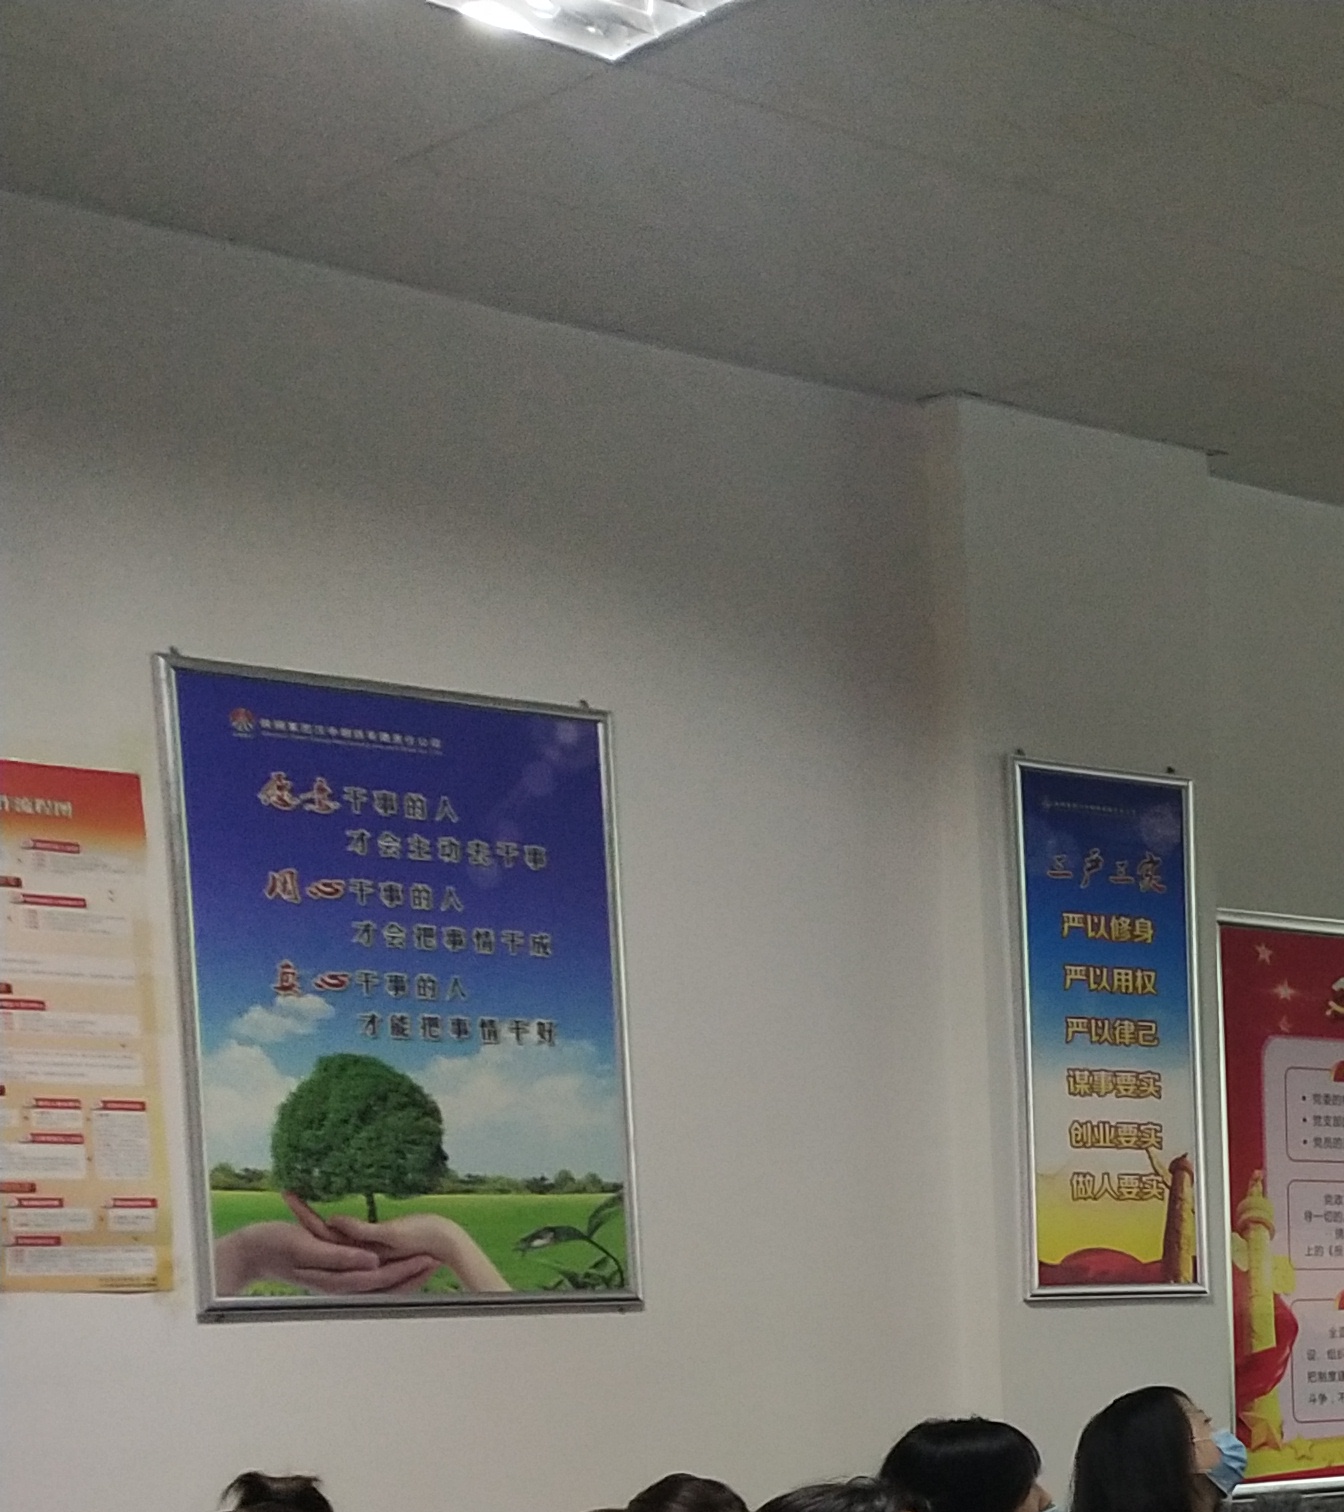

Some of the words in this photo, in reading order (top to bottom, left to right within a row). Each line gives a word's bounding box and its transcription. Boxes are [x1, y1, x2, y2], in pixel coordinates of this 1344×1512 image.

[351, 920, 552, 957] 才会把事情干成
[1062, 912, 1154, 944] 严以修身
[1064, 964, 1157, 995] 严以用权
[357, 1013, 557, 1047] 才能把事情干好
[1066, 1016, 1159, 1047] 严以律己
[1067, 1068, 1162, 1099] 谋事要实
[1069, 1120, 1163, 1150] 创业要实
[1070, 1171, 1165, 1201] 做人要实
